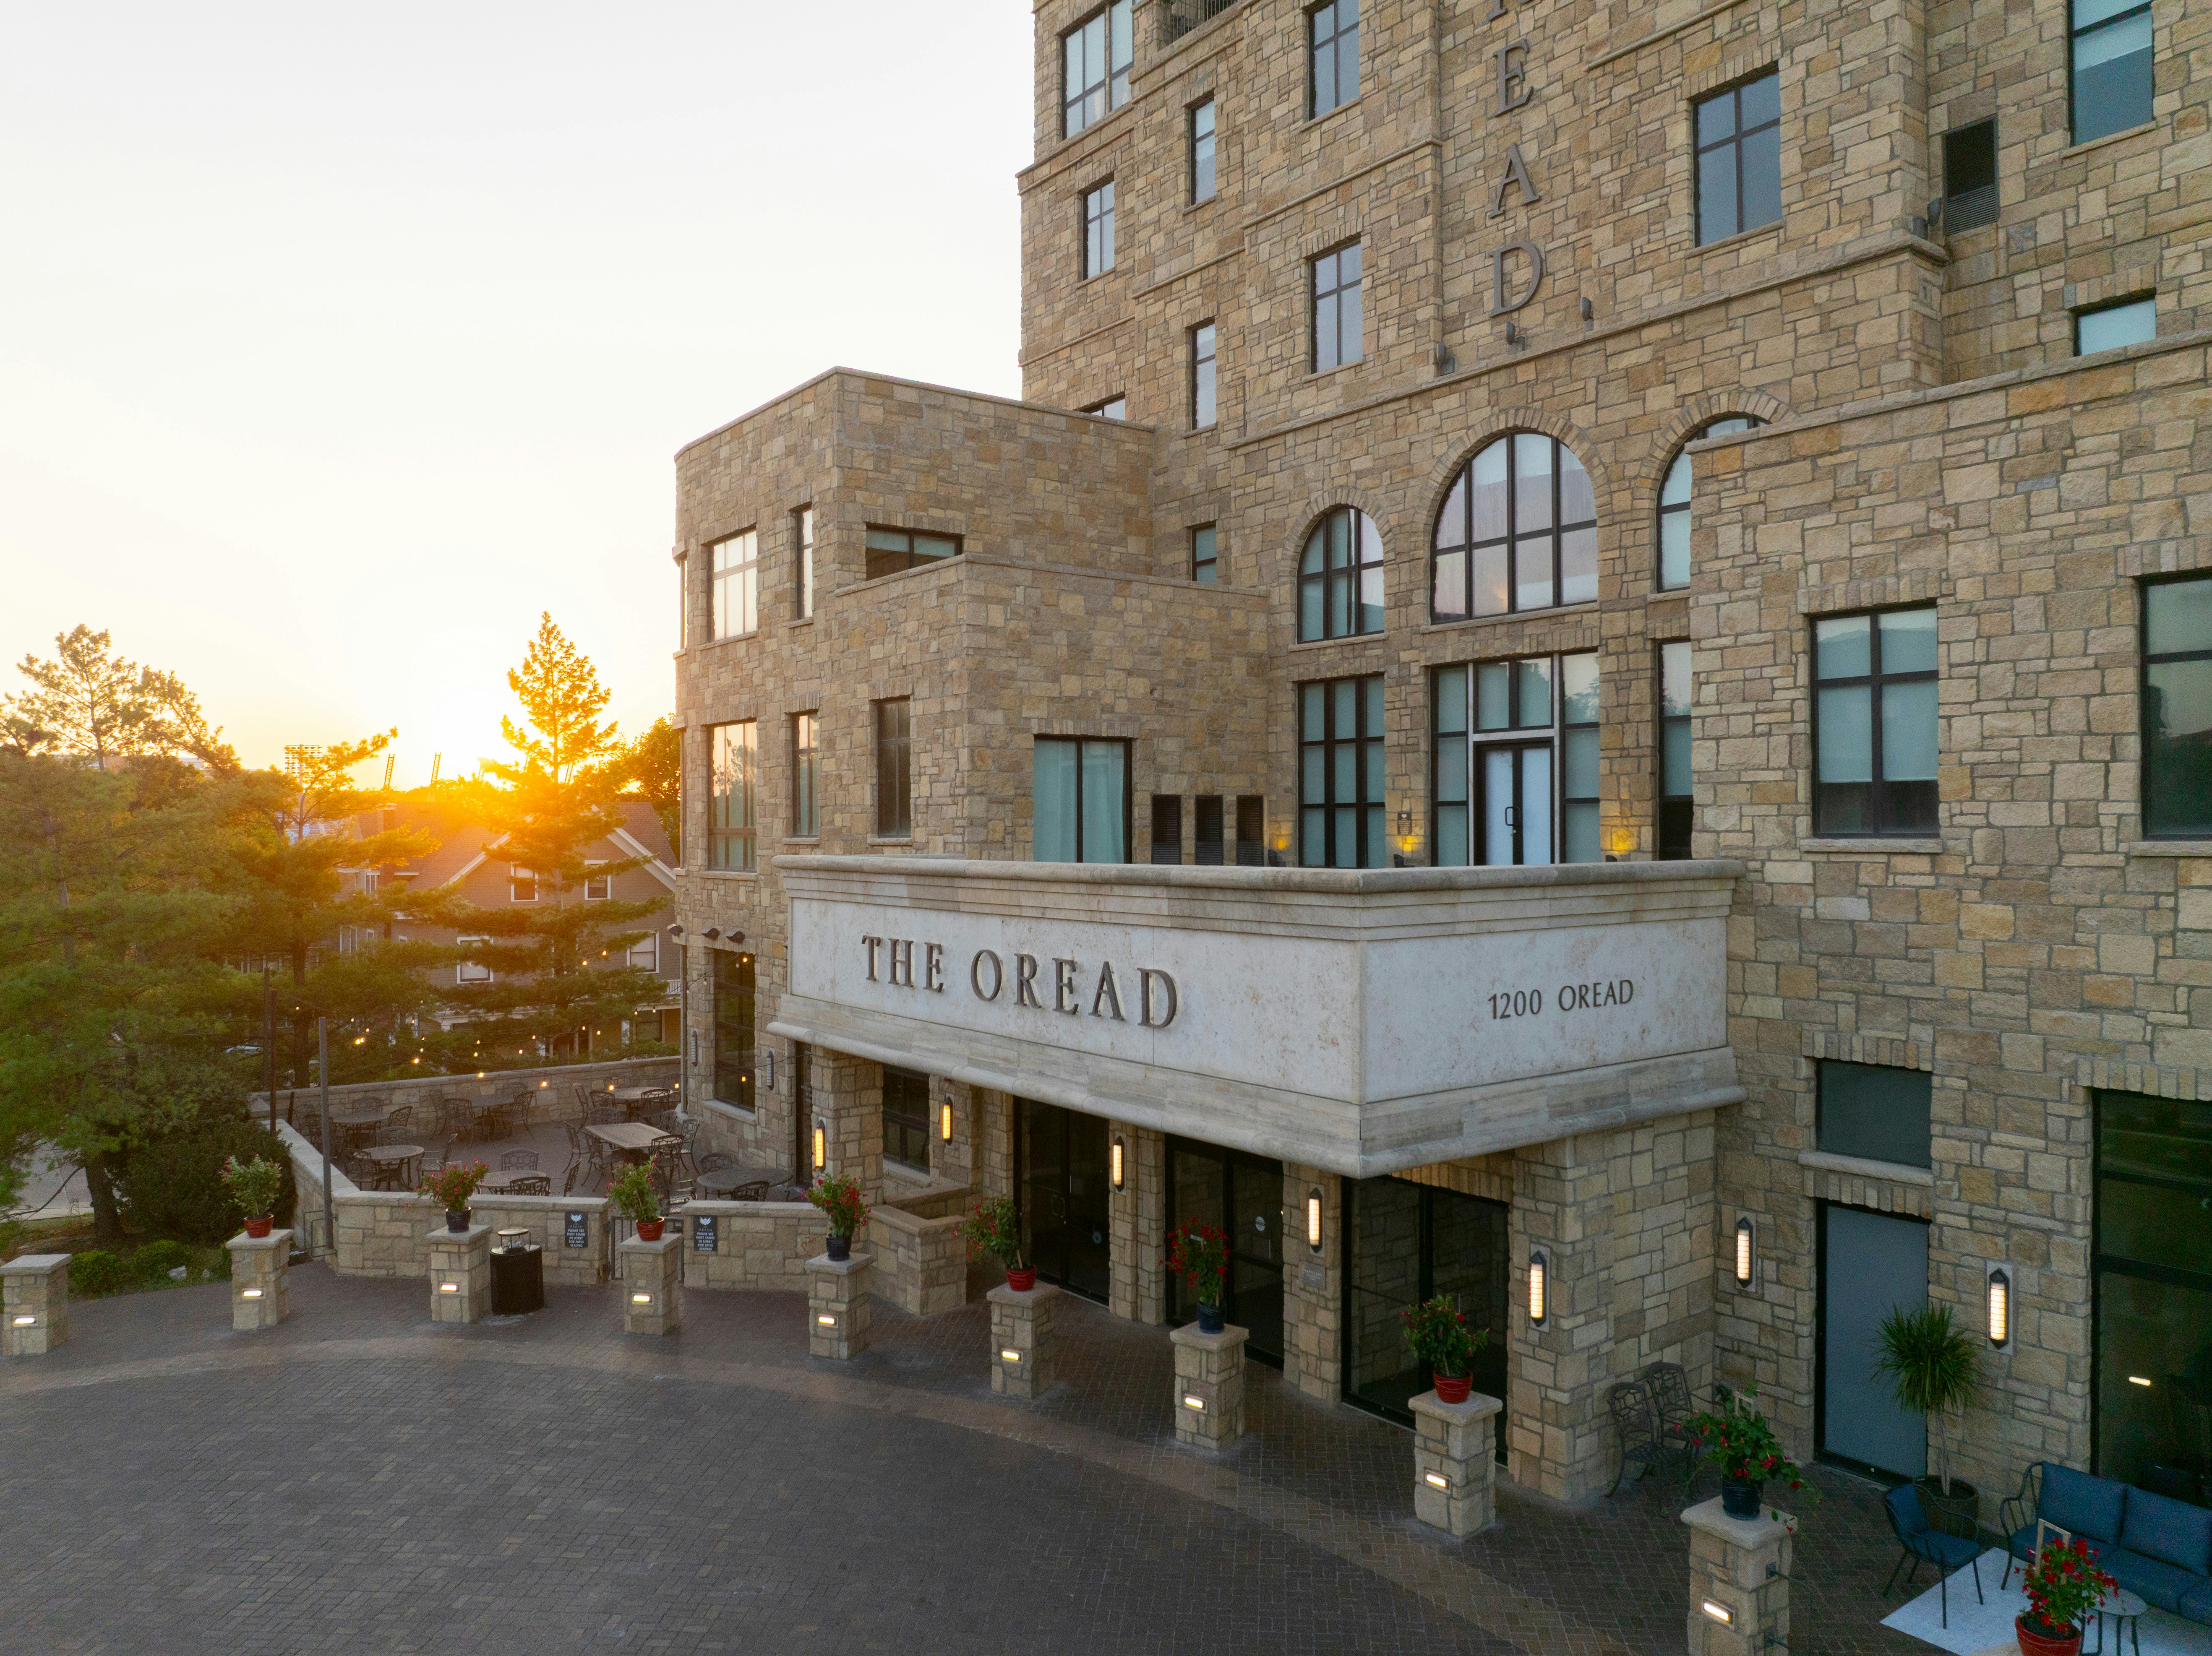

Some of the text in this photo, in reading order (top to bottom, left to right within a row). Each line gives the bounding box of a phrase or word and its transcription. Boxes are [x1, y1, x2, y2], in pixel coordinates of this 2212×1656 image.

[1486, 0, 1544, 318] EAD
[861, 935, 1177, 1028] THE OREAD
[1488, 979, 1633, 1020] 1200 OREAD
